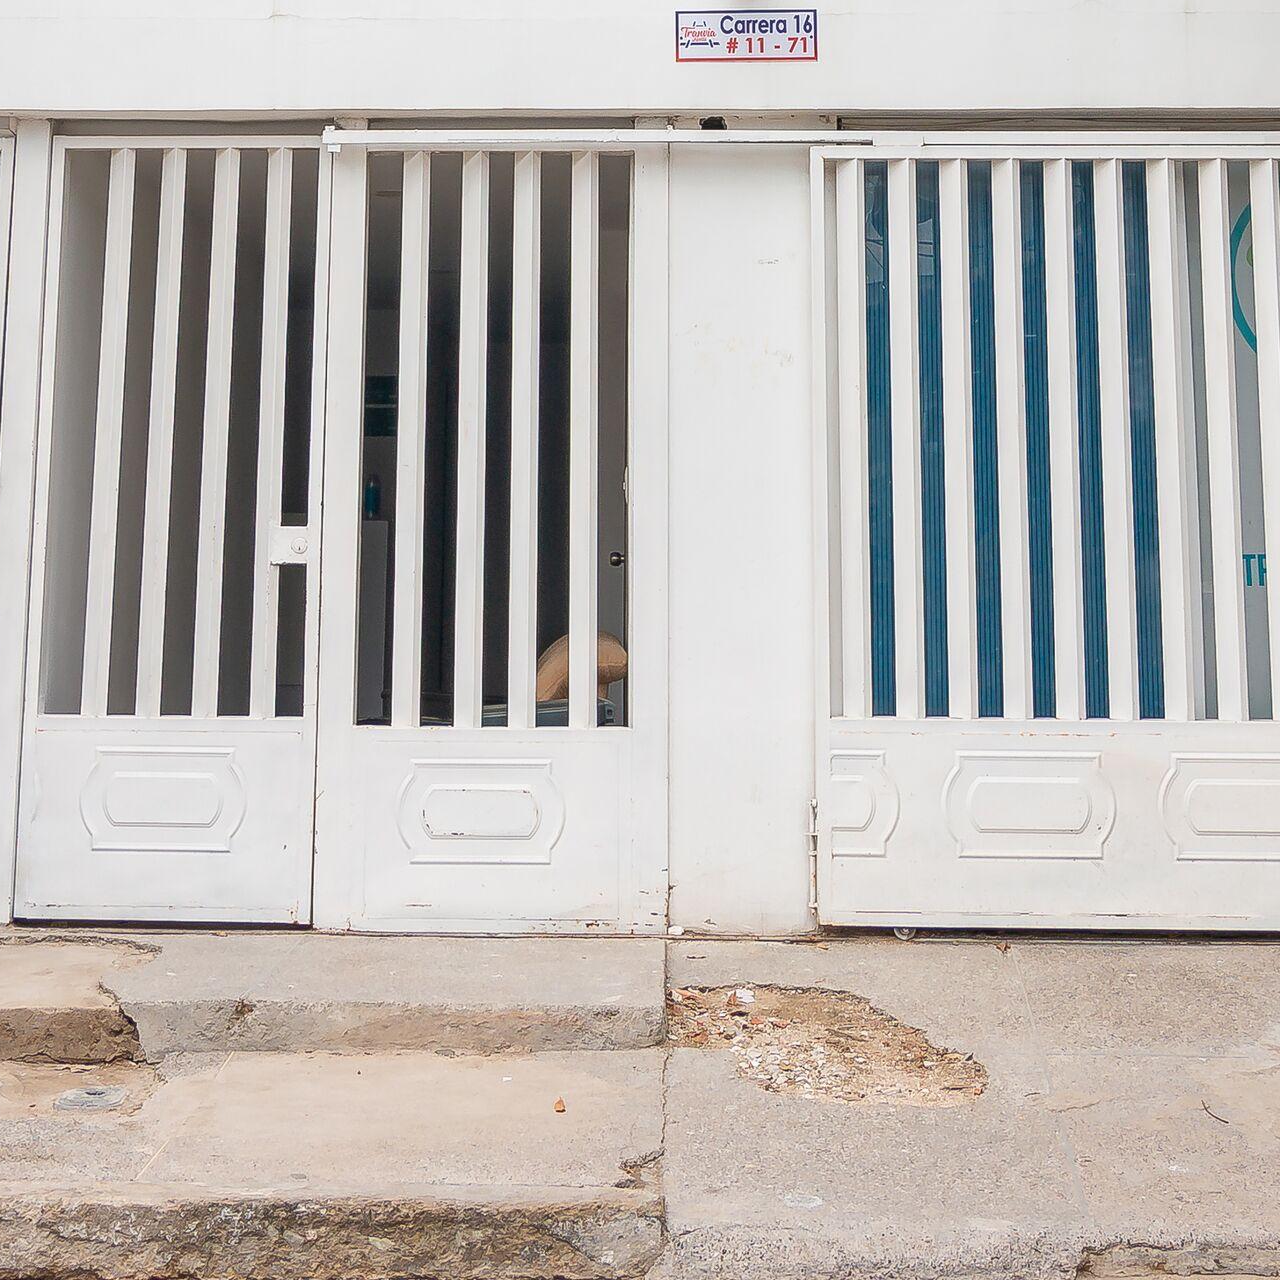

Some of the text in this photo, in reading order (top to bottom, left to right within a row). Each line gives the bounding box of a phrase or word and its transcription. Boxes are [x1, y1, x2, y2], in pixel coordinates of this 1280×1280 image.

[720, 14, 813, 35] Carrera 16
[726, 37, 739, 54] #
[745, 38, 765, 54] 11
[787, 37, 808, 53] 71
